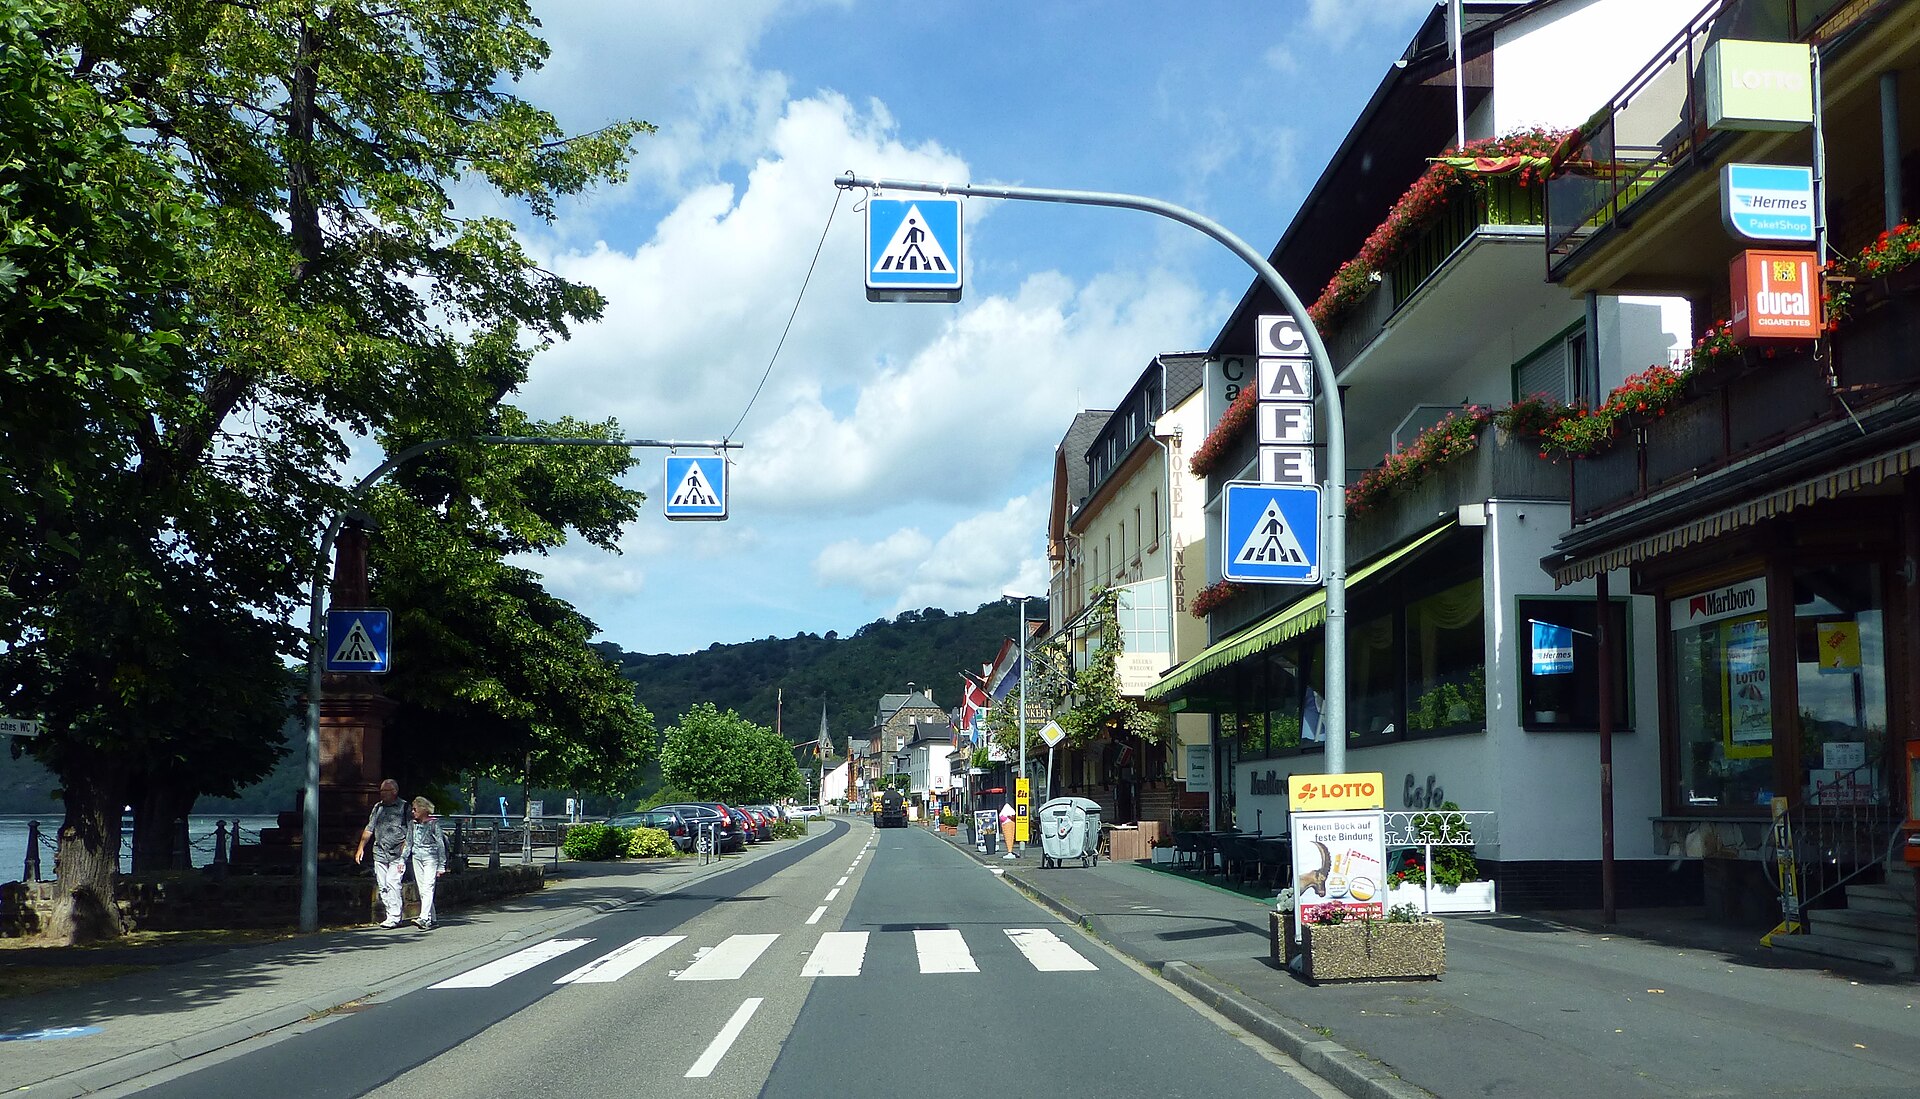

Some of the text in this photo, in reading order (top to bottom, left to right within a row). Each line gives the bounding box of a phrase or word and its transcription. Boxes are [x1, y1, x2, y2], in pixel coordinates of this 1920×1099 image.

[1731, 69, 1804, 91] LOTTO
[1752, 195, 1807, 210] Hermes
[1750, 218, 1807, 232] PaketShop
[1757, 260, 1810, 316] ducal
[1758, 318, 1811, 327] CIGARETTES
[1269, 320, 1304, 482] CAFE
[1173, 531, 1187, 612] ANKER
[1707, 587, 1756, 617] Marlboro
[1543, 651, 1572, 659] Hermes
[1736, 669, 1766, 685] LOTTO
[0, 721, 31, 733] ches WC
[1017, 789, 1028, 798] Eis
[1321, 782, 1375, 798] LOTTO
[1302, 820, 1372, 831] Keinen Bock auf
[1314, 831, 1374, 842] feste Bindung
